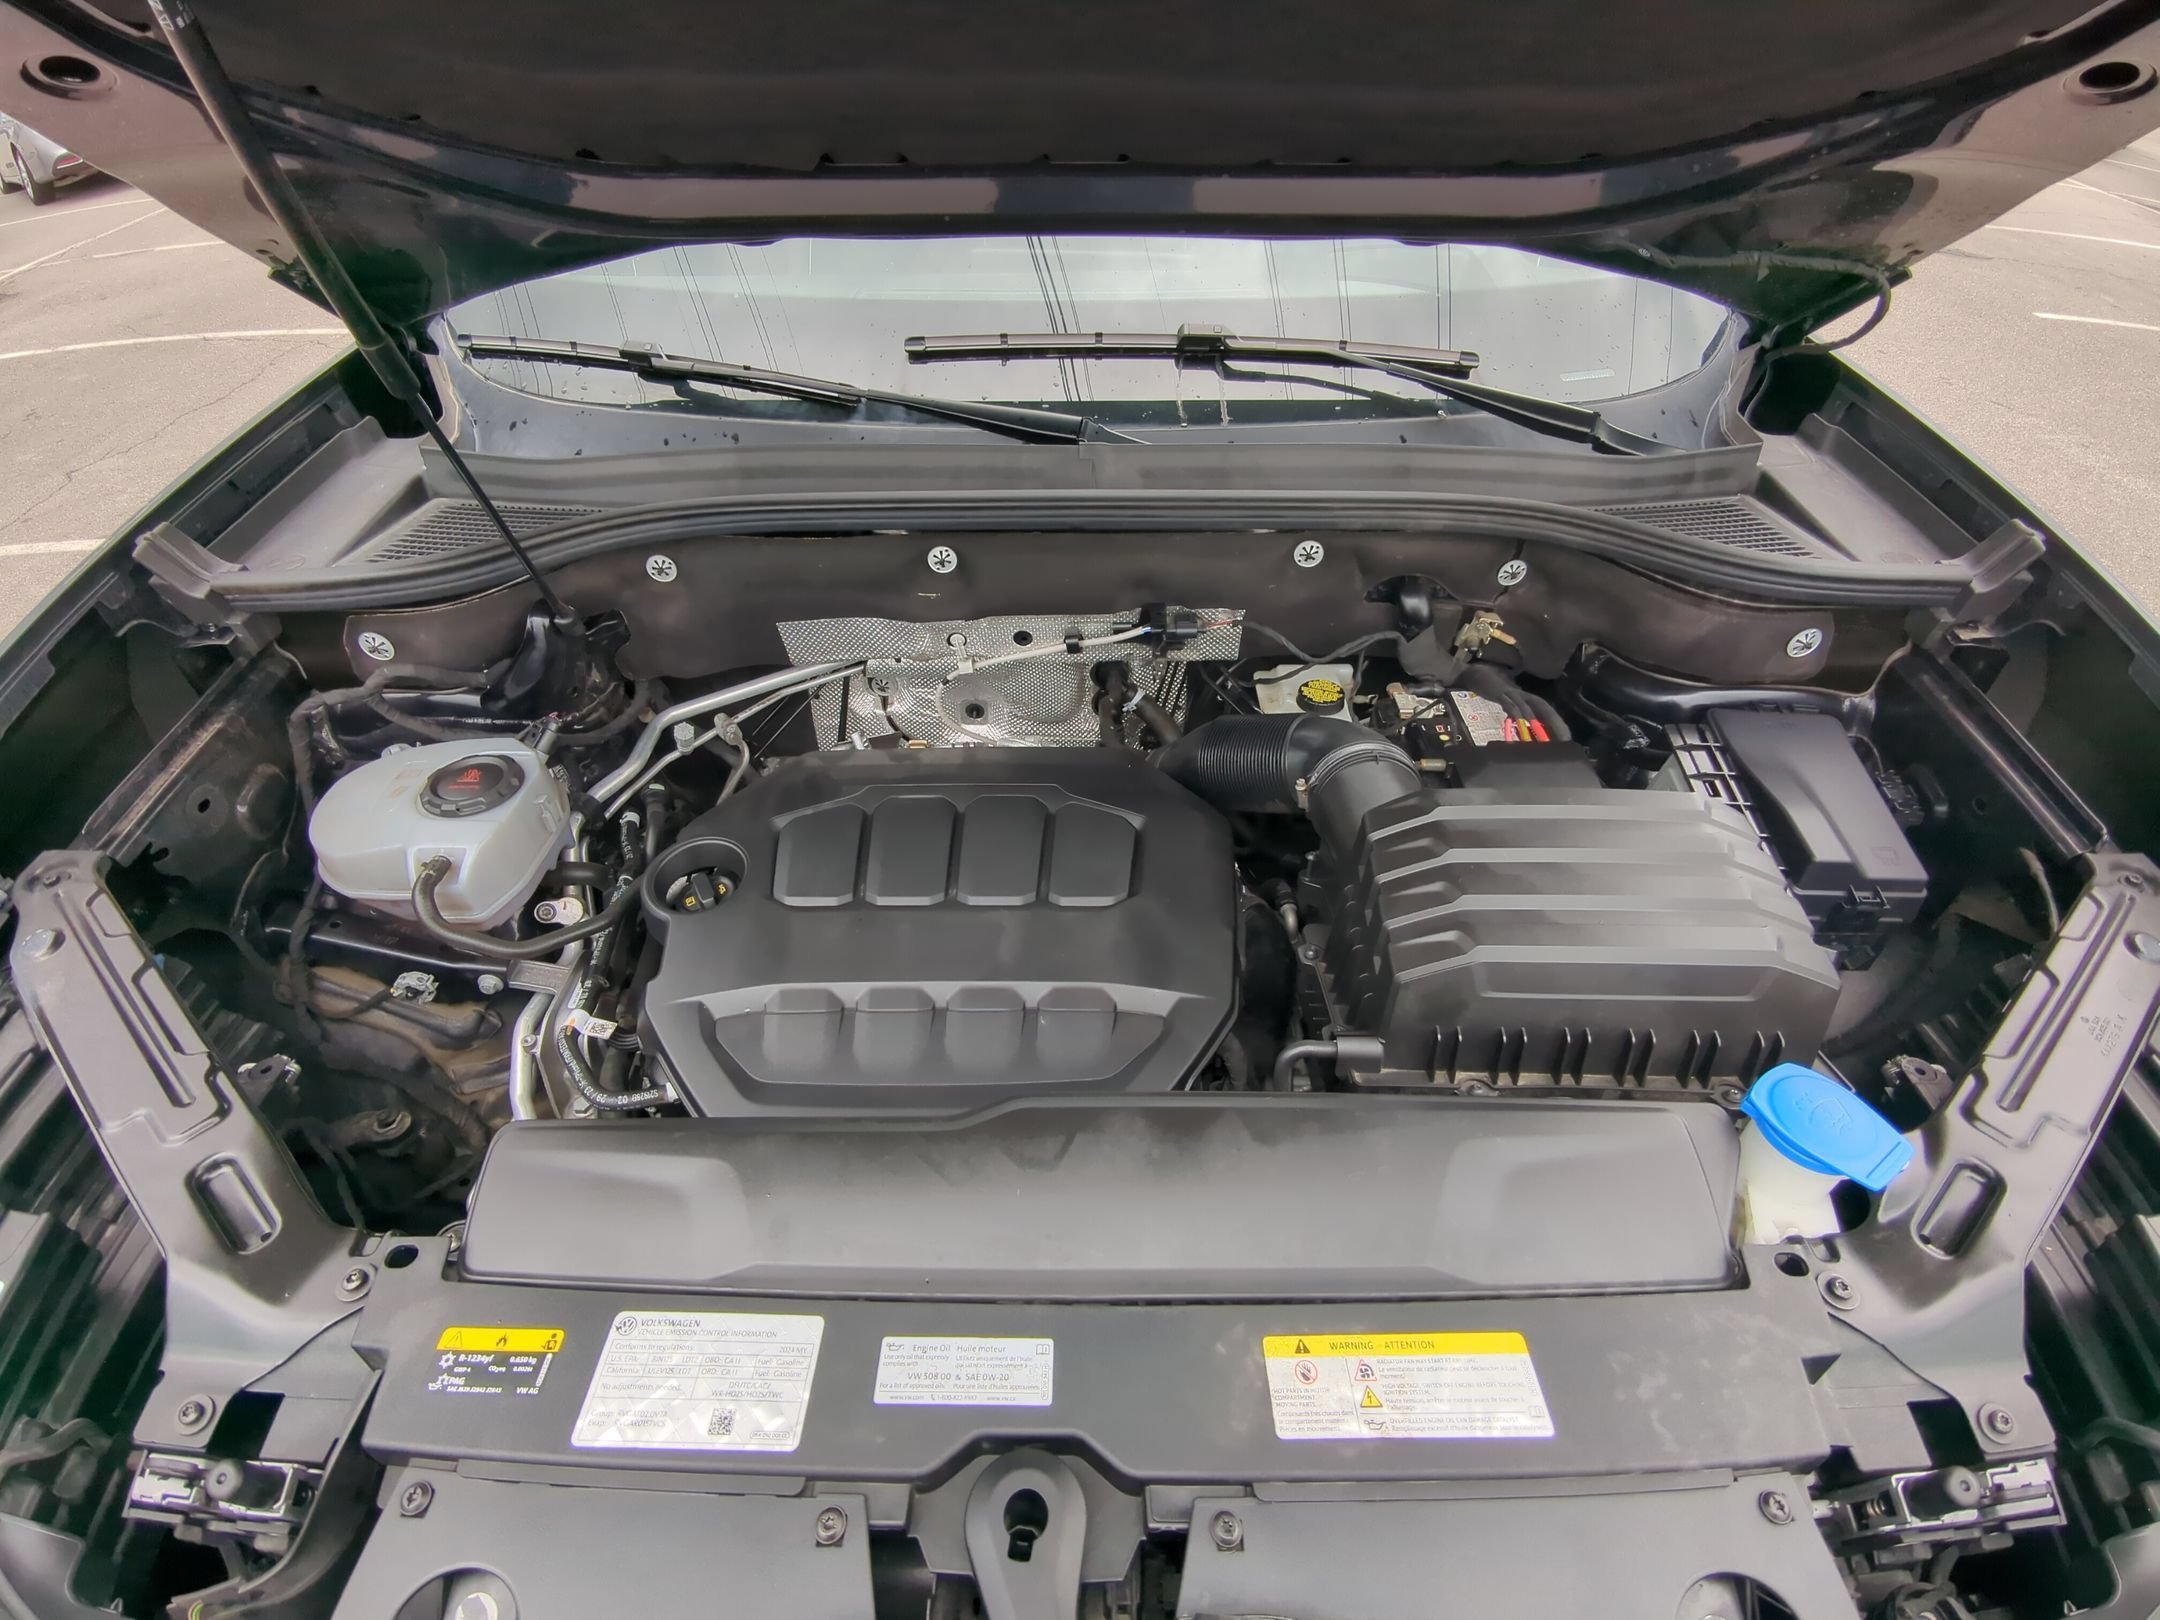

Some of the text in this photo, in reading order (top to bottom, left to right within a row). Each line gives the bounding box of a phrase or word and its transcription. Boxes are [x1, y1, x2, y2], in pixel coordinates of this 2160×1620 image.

[641, 1319, 701, 1328] VOLKSWAGEN
[731, 1330, 777, 1338] INFORMATION
[913, 1344, 938, 1353] Engine
[940, 1344, 951, 1352] Oil
[978, 1345, 1006, 1353] moteur
[1329, 1341, 1435, 1350] WARNING ATTENTION
[776, 1358, 803, 1366] Gasoline
[908, 1372, 921, 1380] VW
[924, 1372, 939, 1380] 508
[940, 1372, 951, 1380] 00
[982, 1373, 1009, 1381] 0W-20
[611, 1383, 654, 1392] adjustments
